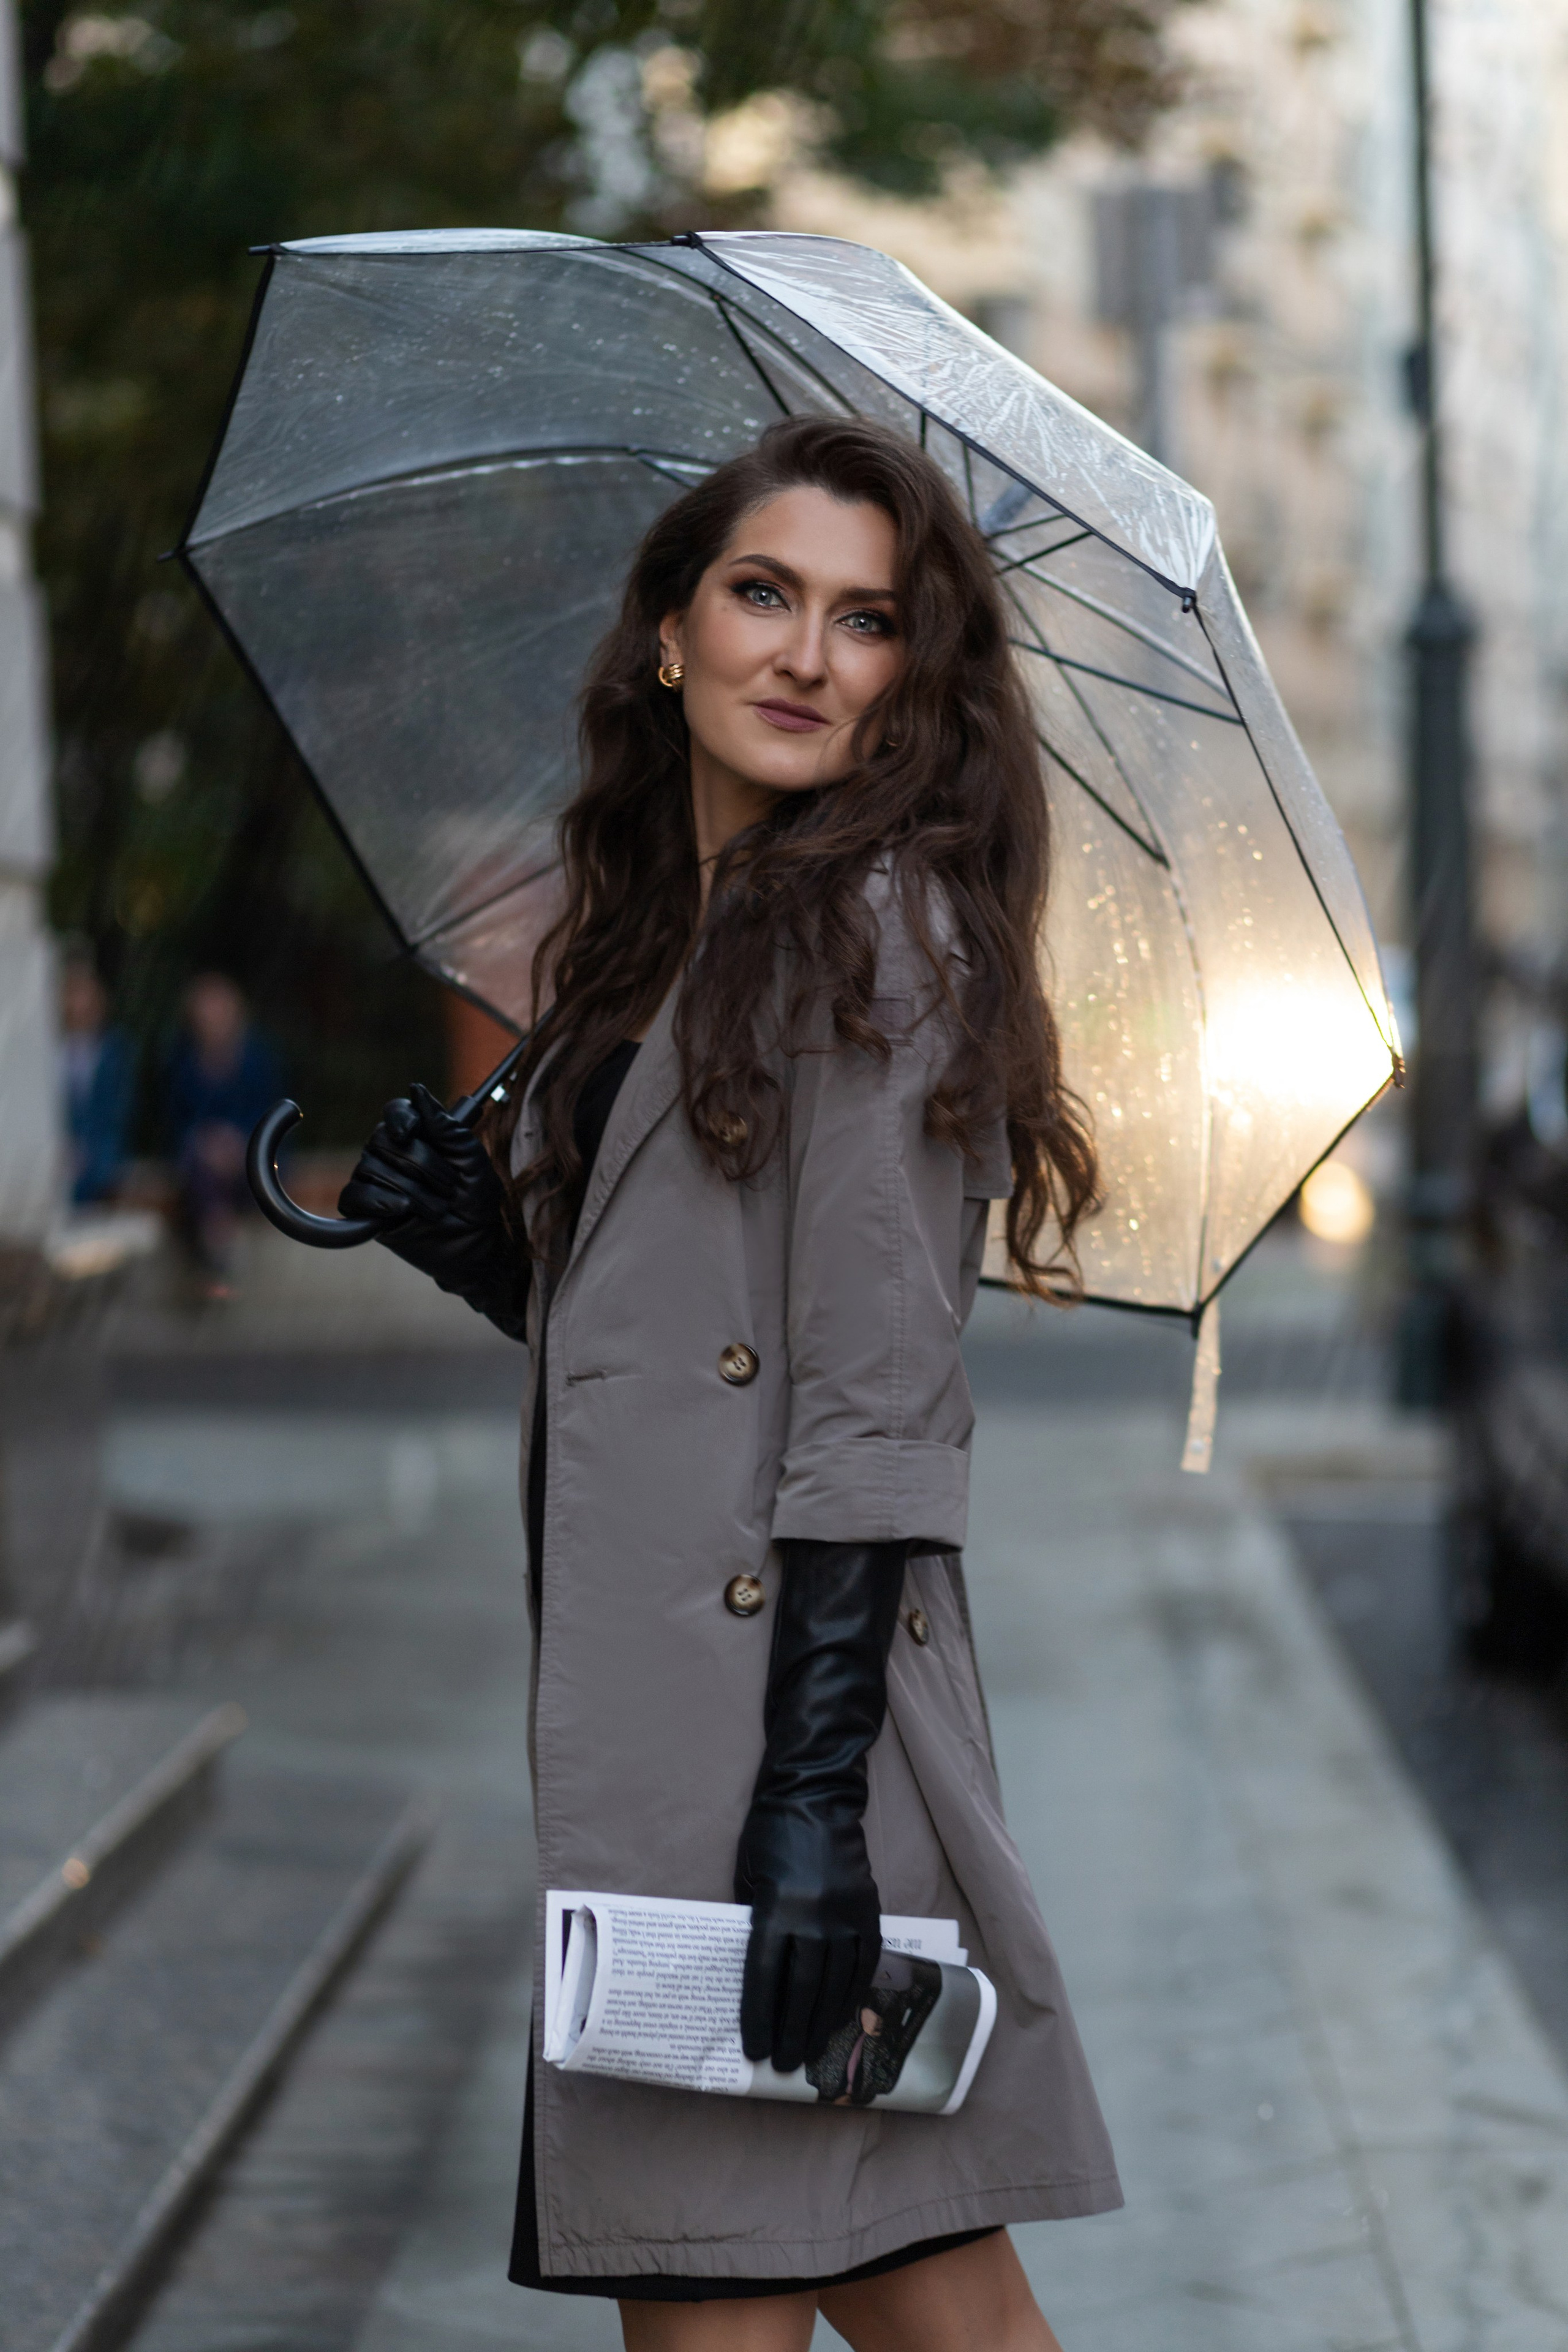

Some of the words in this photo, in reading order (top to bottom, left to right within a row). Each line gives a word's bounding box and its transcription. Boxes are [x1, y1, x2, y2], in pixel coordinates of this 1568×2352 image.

[658, 1932, 673, 1941] mind
[639, 1940, 654, 1949] which
[636, 1969, 655, 1980] people
[656, 1973, 679, 1982] watched
[623, 1991, 643, 2000] because
[606, 1999, 627, 2008] because
[604, 2007, 620, 2018] plants
[614, 2018, 641, 2030] happening
[599, 2028, 614, 2038] being
[598, 2056, 615, 2065] about
